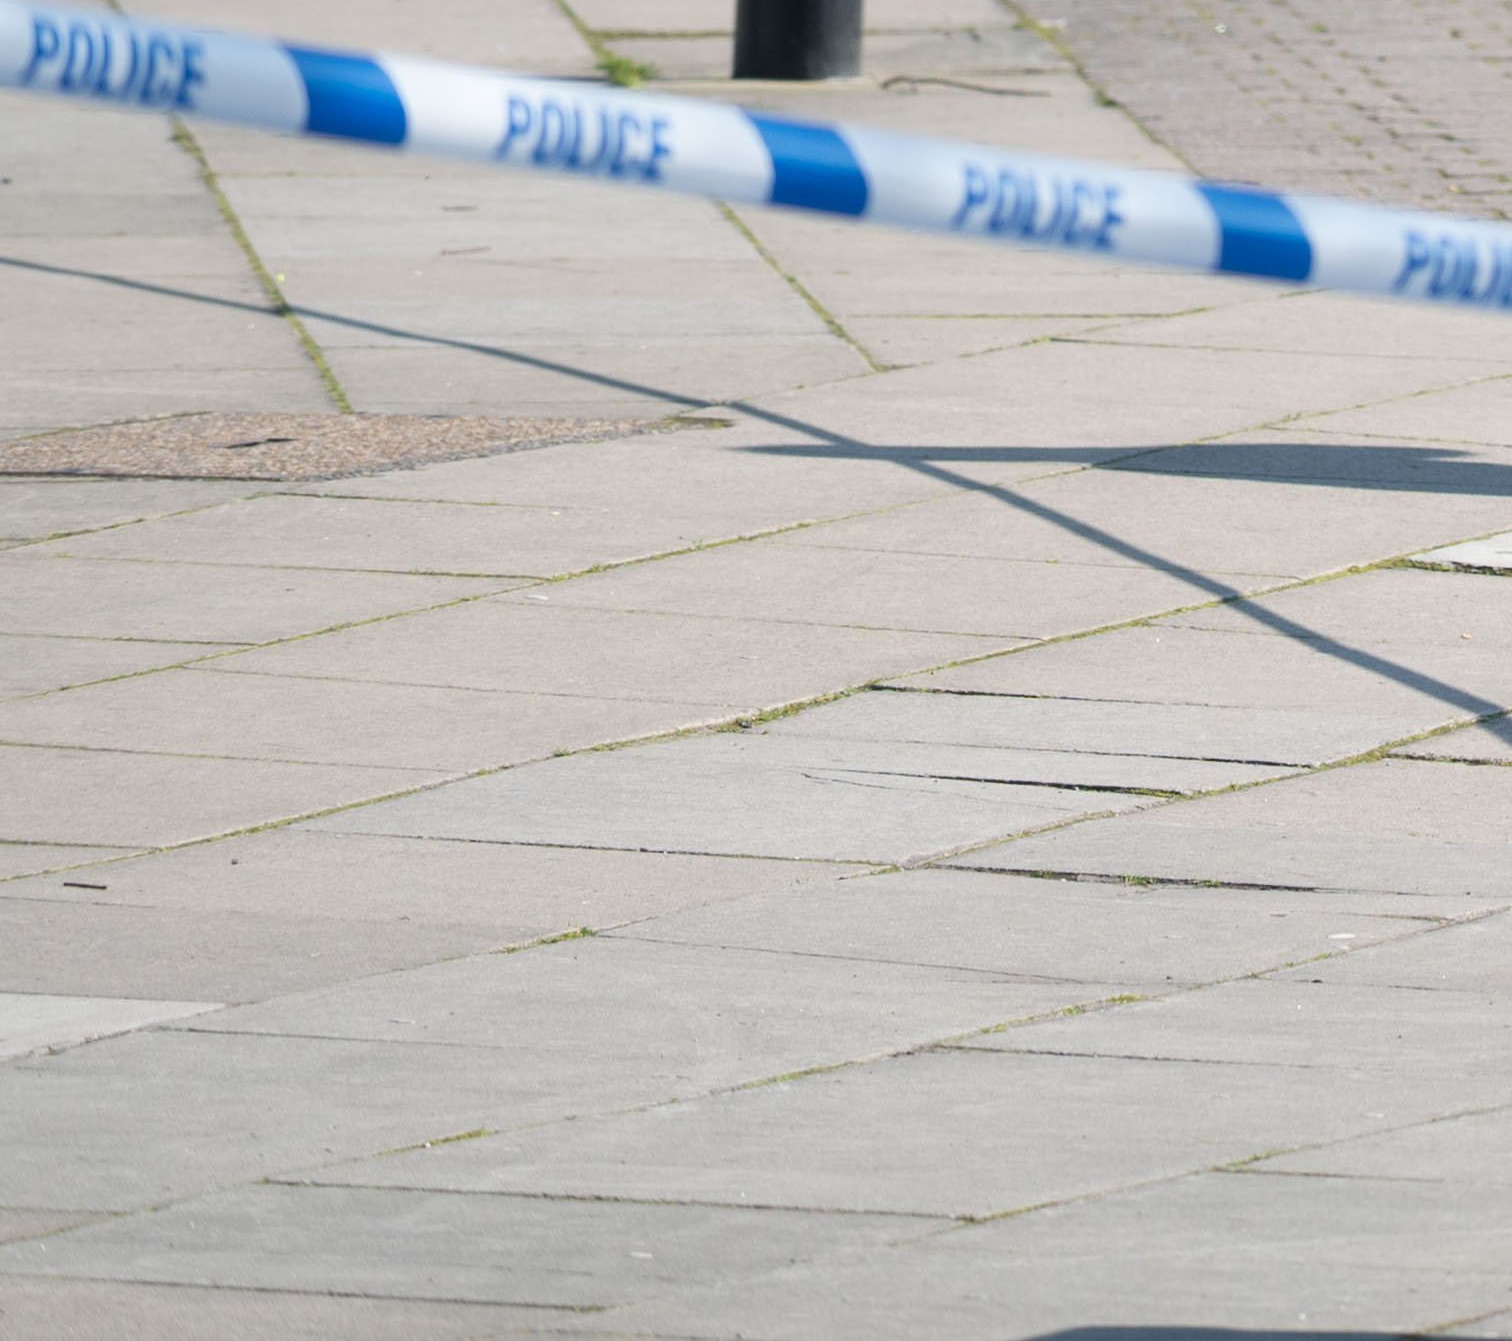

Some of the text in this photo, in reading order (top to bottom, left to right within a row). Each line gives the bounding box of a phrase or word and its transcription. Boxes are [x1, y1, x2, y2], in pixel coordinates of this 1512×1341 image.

[27, 18, 203, 108] POLICE
[498, 96, 672, 180] POLICE
[954, 165, 1124, 249] POLICE
